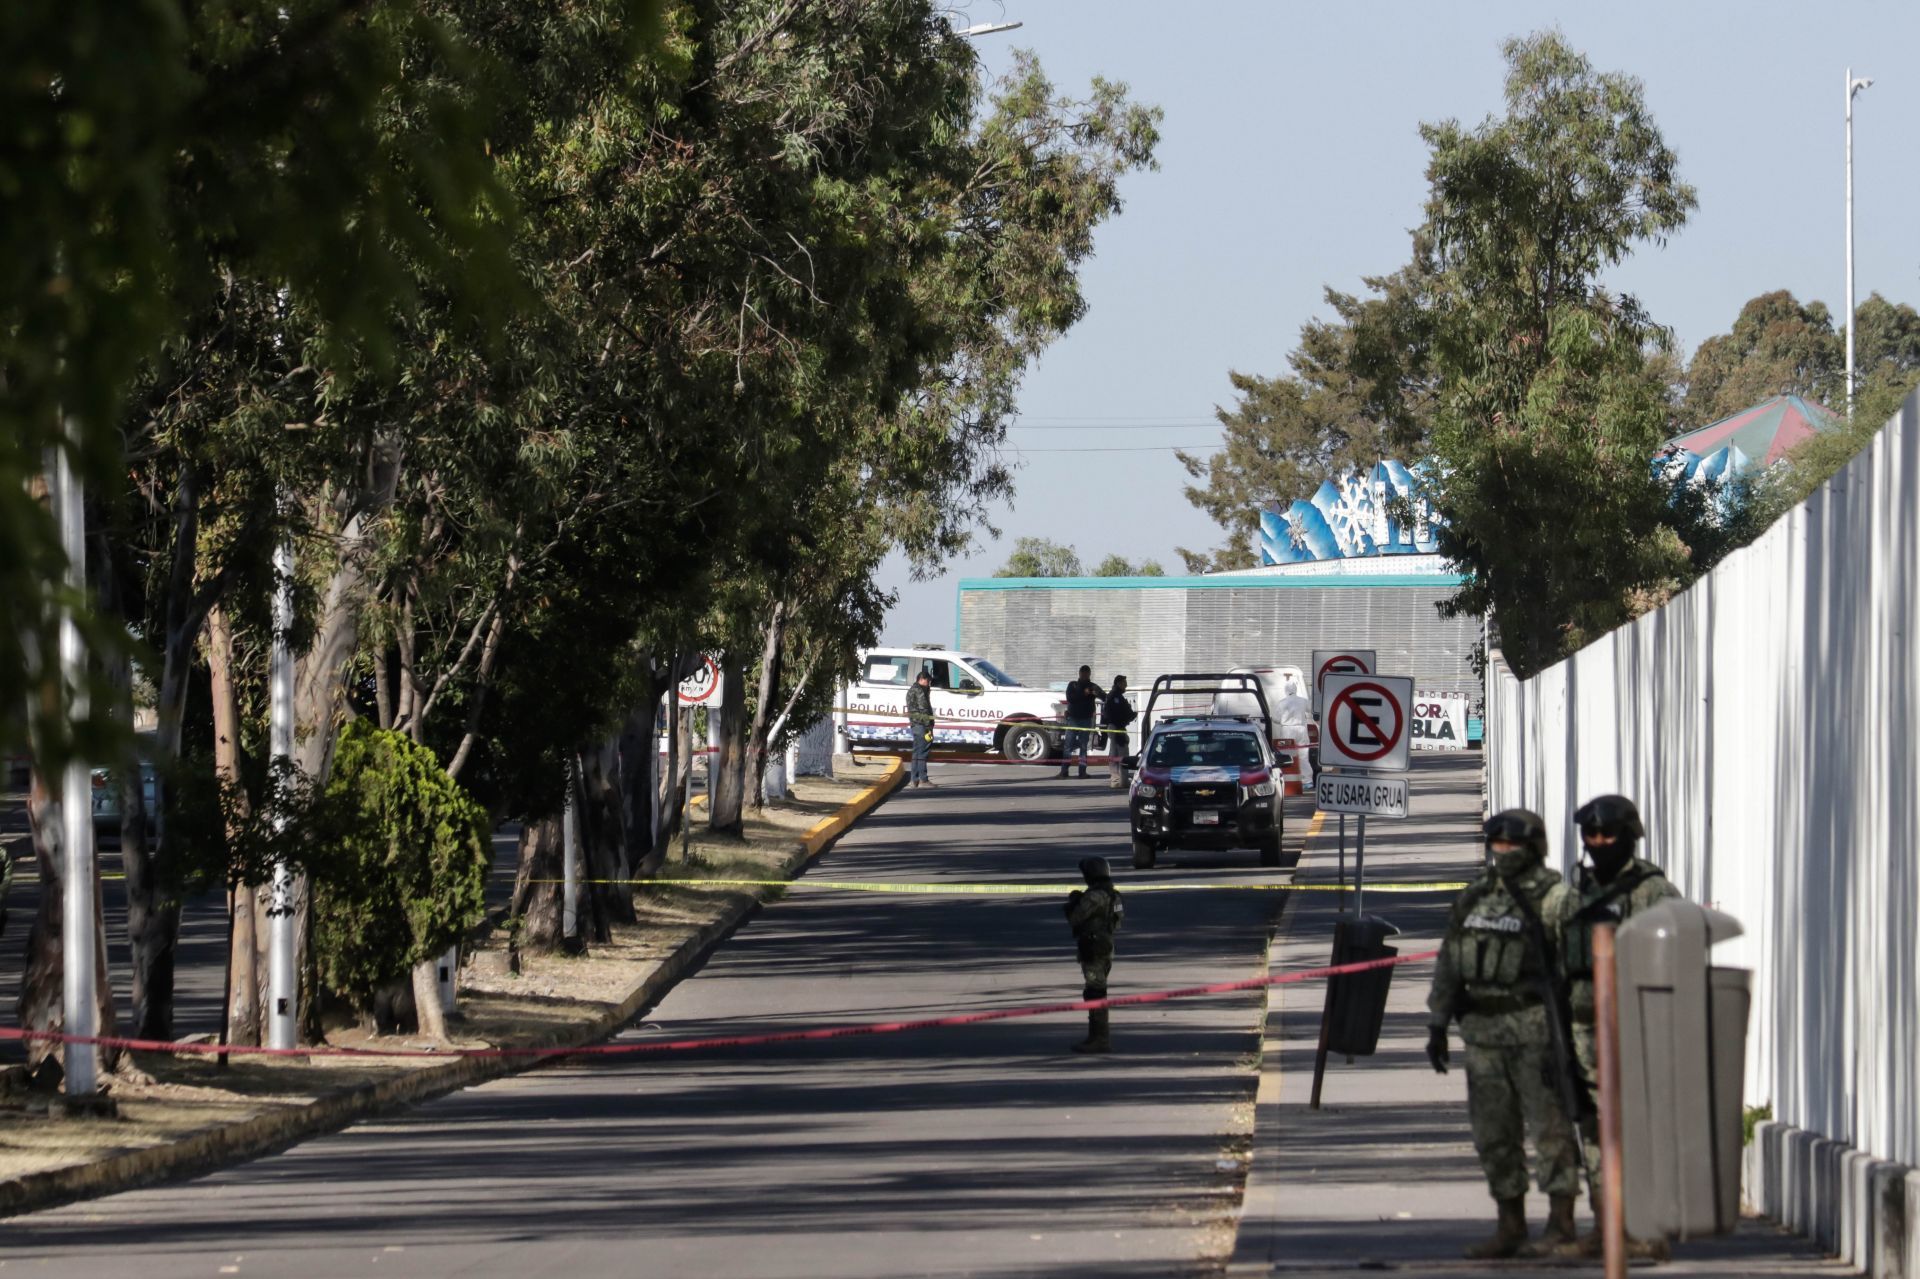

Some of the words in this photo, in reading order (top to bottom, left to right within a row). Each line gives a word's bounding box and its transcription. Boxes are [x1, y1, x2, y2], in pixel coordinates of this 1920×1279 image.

[940, 707, 954, 717] LA
[958, 708, 1004, 719] CIUDAD
[1320, 782, 1334, 804] SE
[1336, 783, 1372, 808] USARA
[1374, 786, 1403, 809] GRUA
